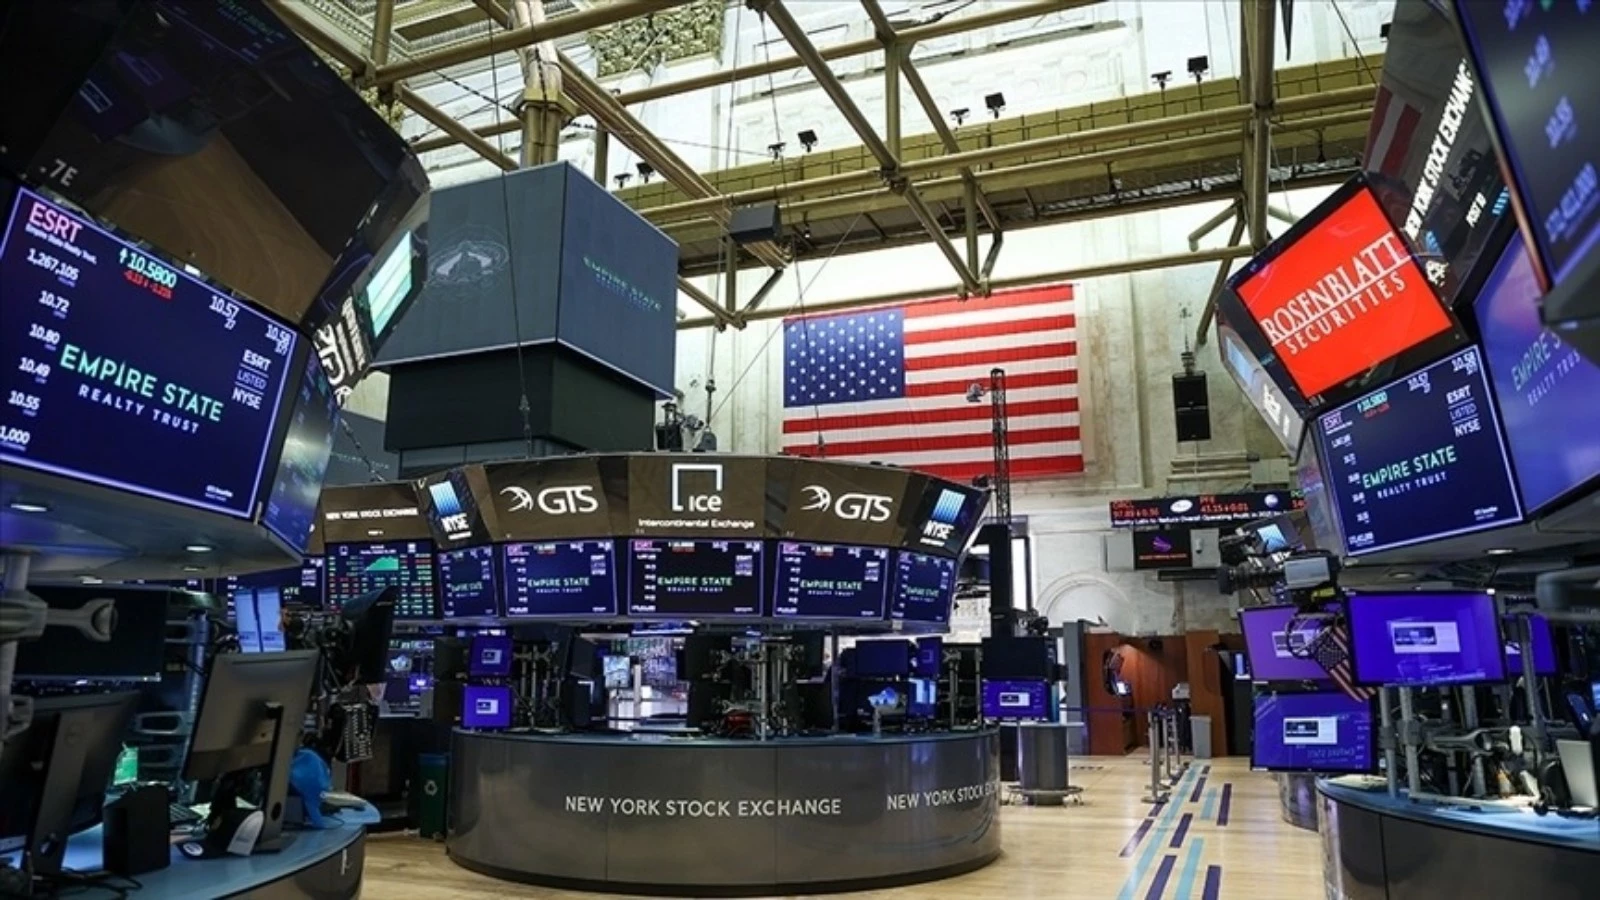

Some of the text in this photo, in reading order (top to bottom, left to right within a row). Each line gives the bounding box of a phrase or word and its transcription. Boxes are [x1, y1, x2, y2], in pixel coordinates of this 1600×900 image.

[1423, 133, 1450, 187] STOCK
[1439, 58, 1474, 145] EXCHANG
[29, 201, 83, 242] ESRT
[127, 252, 178, 289] 10.5800
[1260, 231, 1408, 346] ROSENBLATT
[38, 290, 70, 313] 10.72
[209, 295, 240, 320] 10.57
[1285, 271, 1406, 355] SECURITIES
[242, 349, 271, 371] ESRT
[60, 343, 224, 422] EMPIRE STATE
[237, 370, 267, 390] LISTED
[8, 390, 41, 410] 10.55
[231, 386, 262, 410] NYSE
[1446, 385, 1471, 404] ESRT
[78, 383, 200, 434] REALTY TRUST
[1450, 403, 1477, 420] LISTED
[1454, 418, 1481, 437] NYSE
[1362, 460, 1411, 488] EMPIRE
[1412, 445, 1457, 473] STATE
[1377, 482, 1411, 499] REALTY
[1415, 471, 1447, 488] TRUST
[537, 485, 599, 515] GTS
[834, 493, 893, 522] GTS
[638, 518, 755, 530] Intercontinental Exchange
[923, 519, 954, 540] NYSE
[528, 577, 590, 588] EMPIRE STATE
[657, 576, 733, 586] EMPIRE STATE
[800, 579, 862, 591] EMPIRE STATE
[565, 796, 842, 817] NEW YORK STOCK EXCHANGE
[887, 793, 919, 811] NEW
[923, 790, 956, 807] YORK
[957, 785, 983, 803] STOCK
